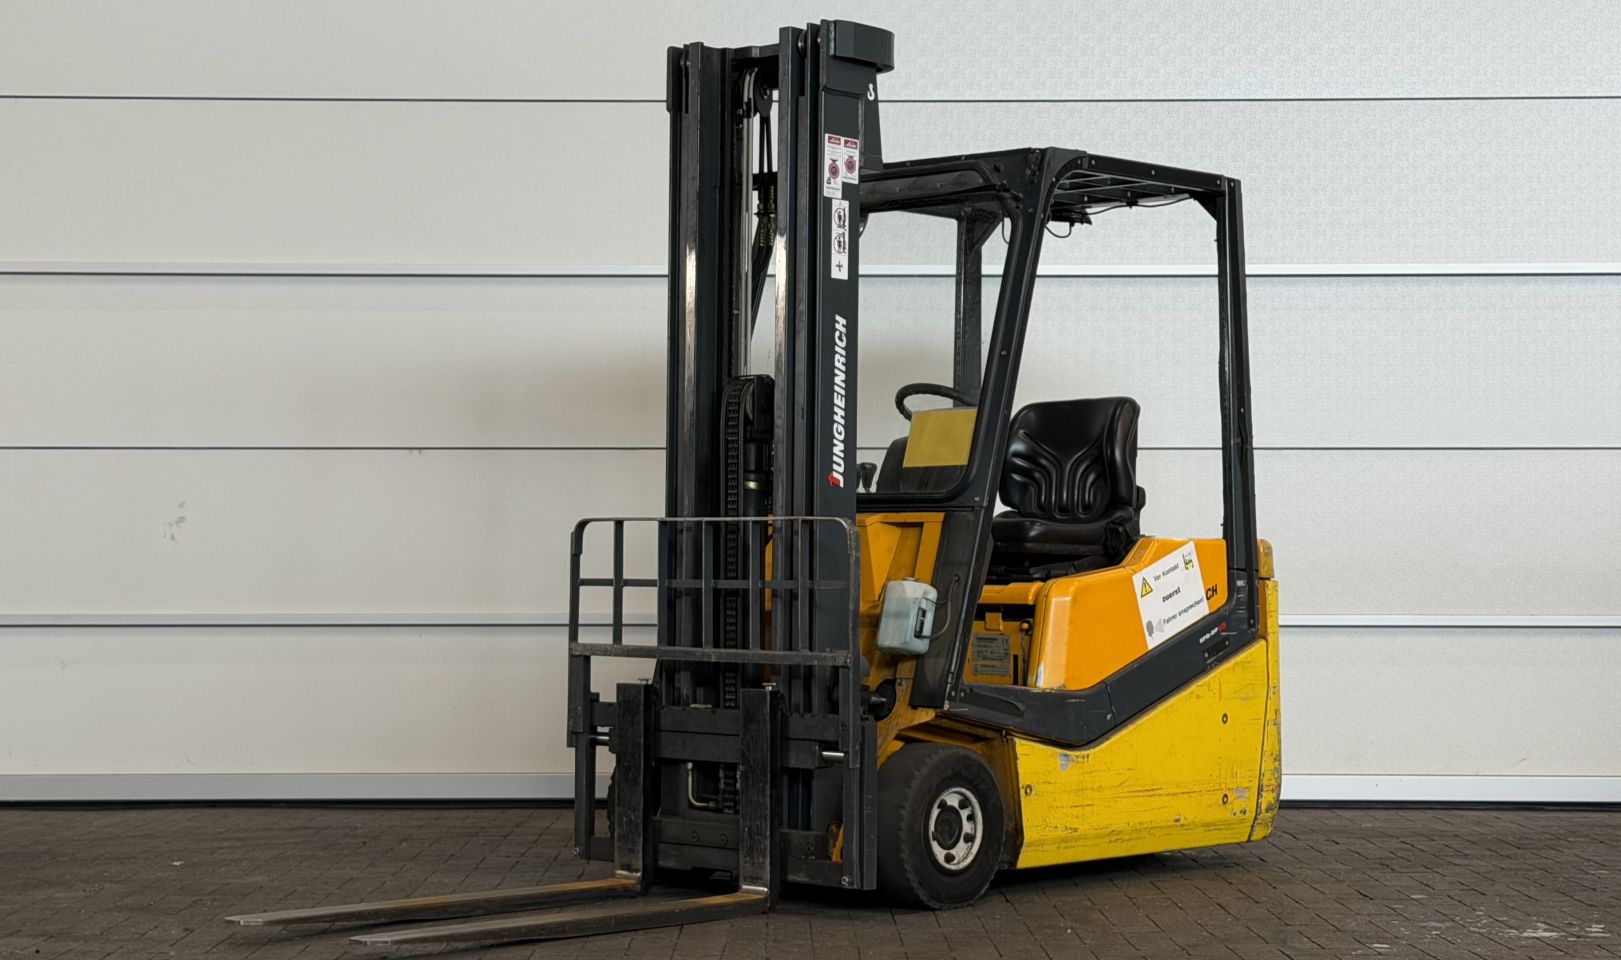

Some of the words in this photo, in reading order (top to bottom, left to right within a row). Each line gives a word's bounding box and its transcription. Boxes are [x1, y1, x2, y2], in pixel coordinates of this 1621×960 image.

[828, 314, 847, 488] JUNGHEINRICH
[1153, 574, 1162, 582] Vor
[1162, 563, 1180, 576] Kontakt
[1162, 586, 1181, 603] zuerst
[1163, 614, 1178, 626] Fahrer
